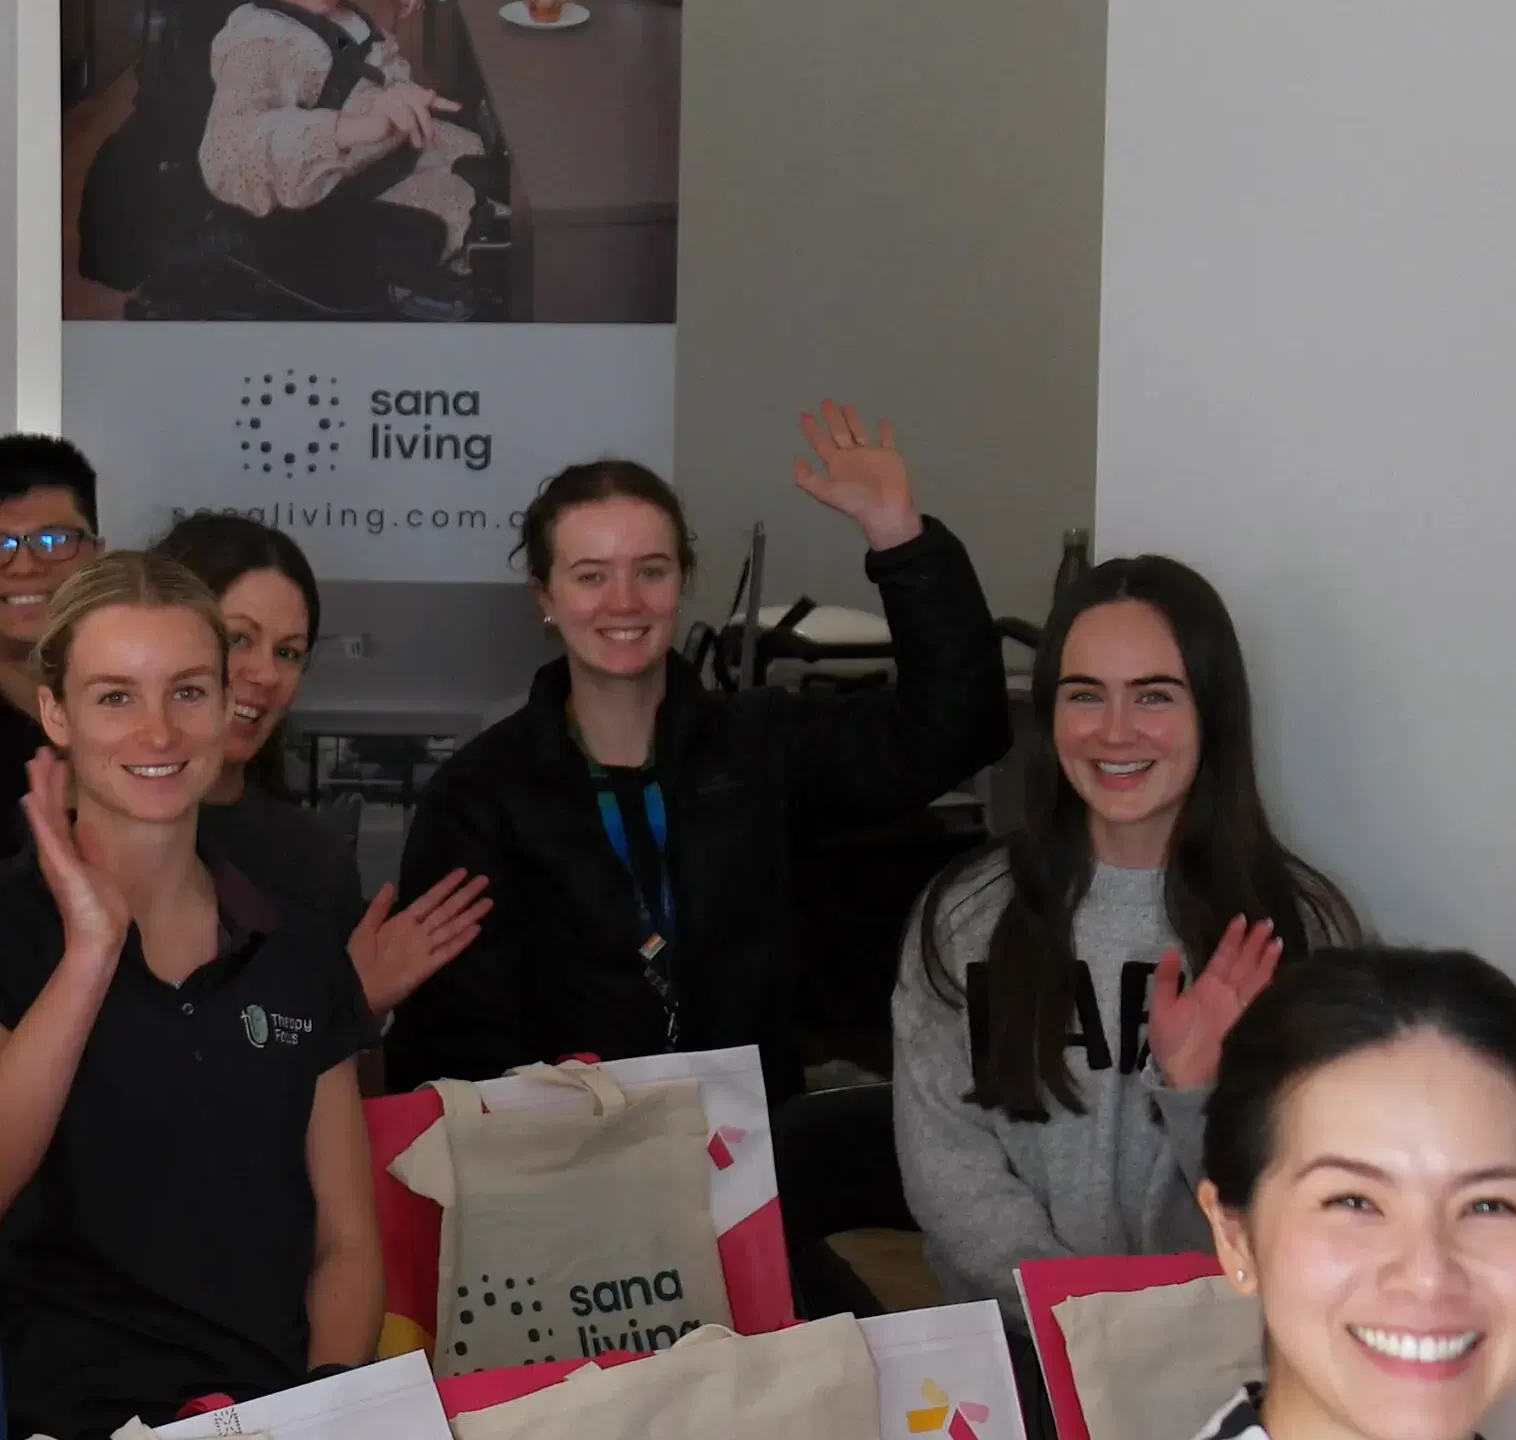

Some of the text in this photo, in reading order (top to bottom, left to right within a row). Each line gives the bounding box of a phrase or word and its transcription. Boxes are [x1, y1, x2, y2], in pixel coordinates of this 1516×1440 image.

[370, 389, 481, 417] sana
[371, 423, 493, 471] living
[570, 1269, 684, 1317] sana
